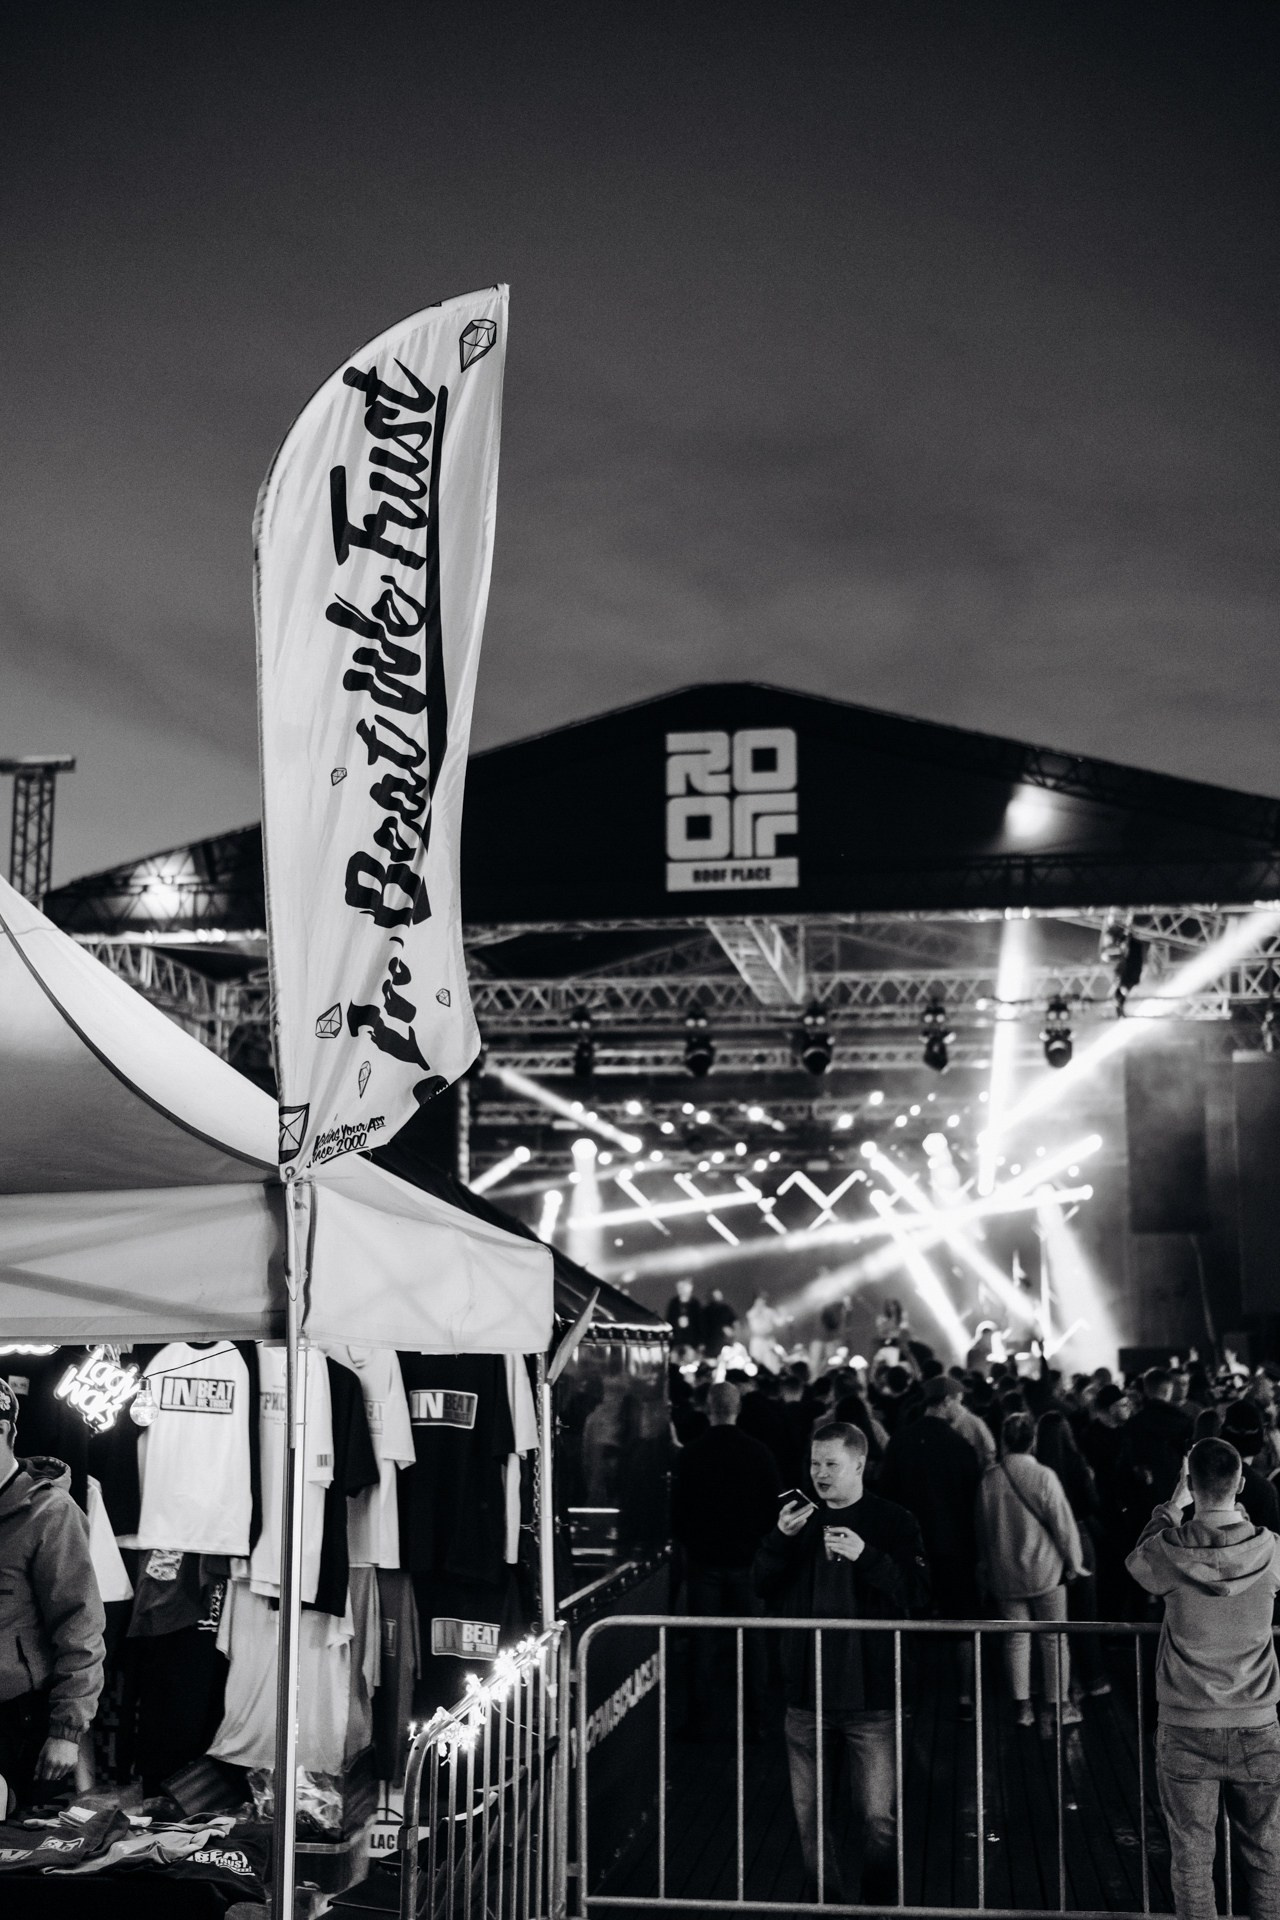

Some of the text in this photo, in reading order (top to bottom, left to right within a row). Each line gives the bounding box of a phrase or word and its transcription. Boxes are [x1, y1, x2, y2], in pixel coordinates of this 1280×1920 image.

[329, 357, 437, 570] Trust
[325, 575, 427, 715] We
[344, 714, 431, 928] Beat
[693, 867, 771, 883] ROOF PLACE
[336, 1132, 368, 1153] 2000
[162, 1377, 235, 1406] IN BEAT
[411, 1392, 444, 1419] IN
[461, 1623, 501, 1646] BEAT
[370, 1833, 396, 1850] LAC
